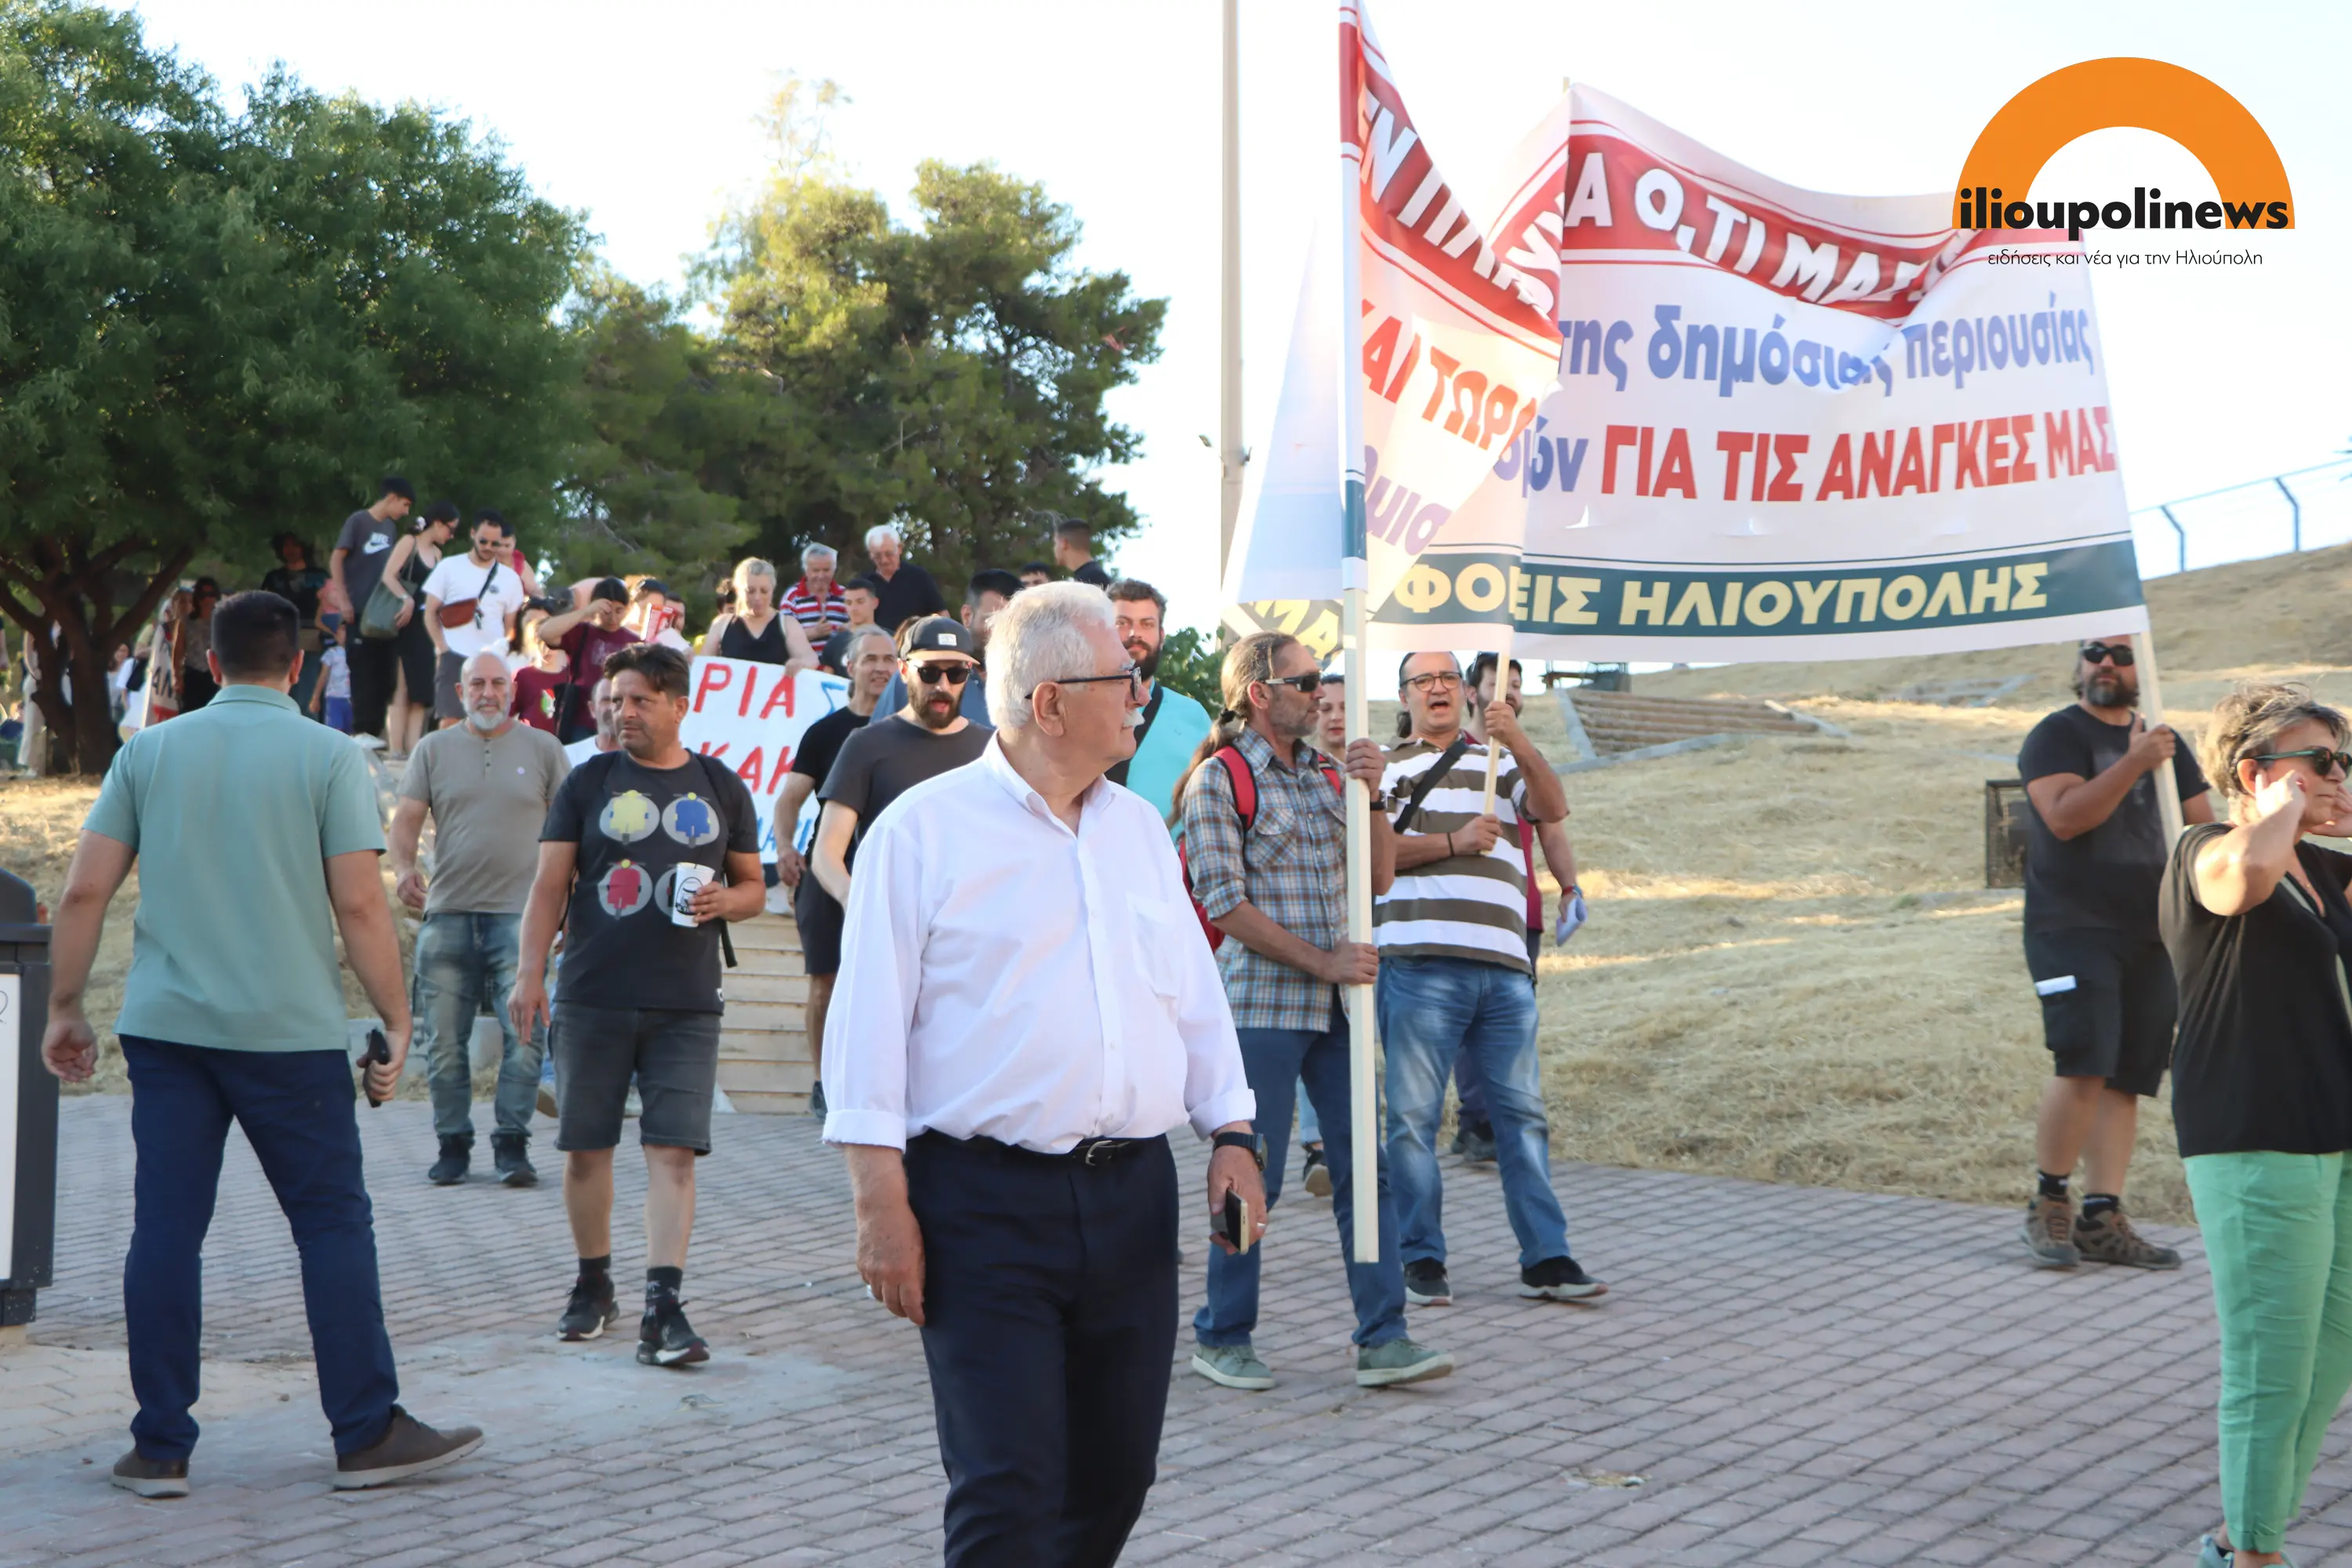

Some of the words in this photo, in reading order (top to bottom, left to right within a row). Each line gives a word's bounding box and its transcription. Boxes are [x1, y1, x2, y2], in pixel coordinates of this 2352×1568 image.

[1564, 152, 1613, 227] Α
[1635, 168, 1766, 275] Ο,ΤΙ
[1900, 290, 2095, 390] περιουσίας
[1602, 424, 1698, 499] ΓΙΑ
[1716, 430, 1810, 502] ΤΙΣ
[1815, 414, 2038, 502] ΑΝΑΓΚΕΣ
[2045, 406, 2118, 479] ΜΑΣ
[1248, 599, 1339, 660] ΜΑ
[1618, 563, 2049, 626] ΗΛΙΟΥΠΟΛΗΣ
